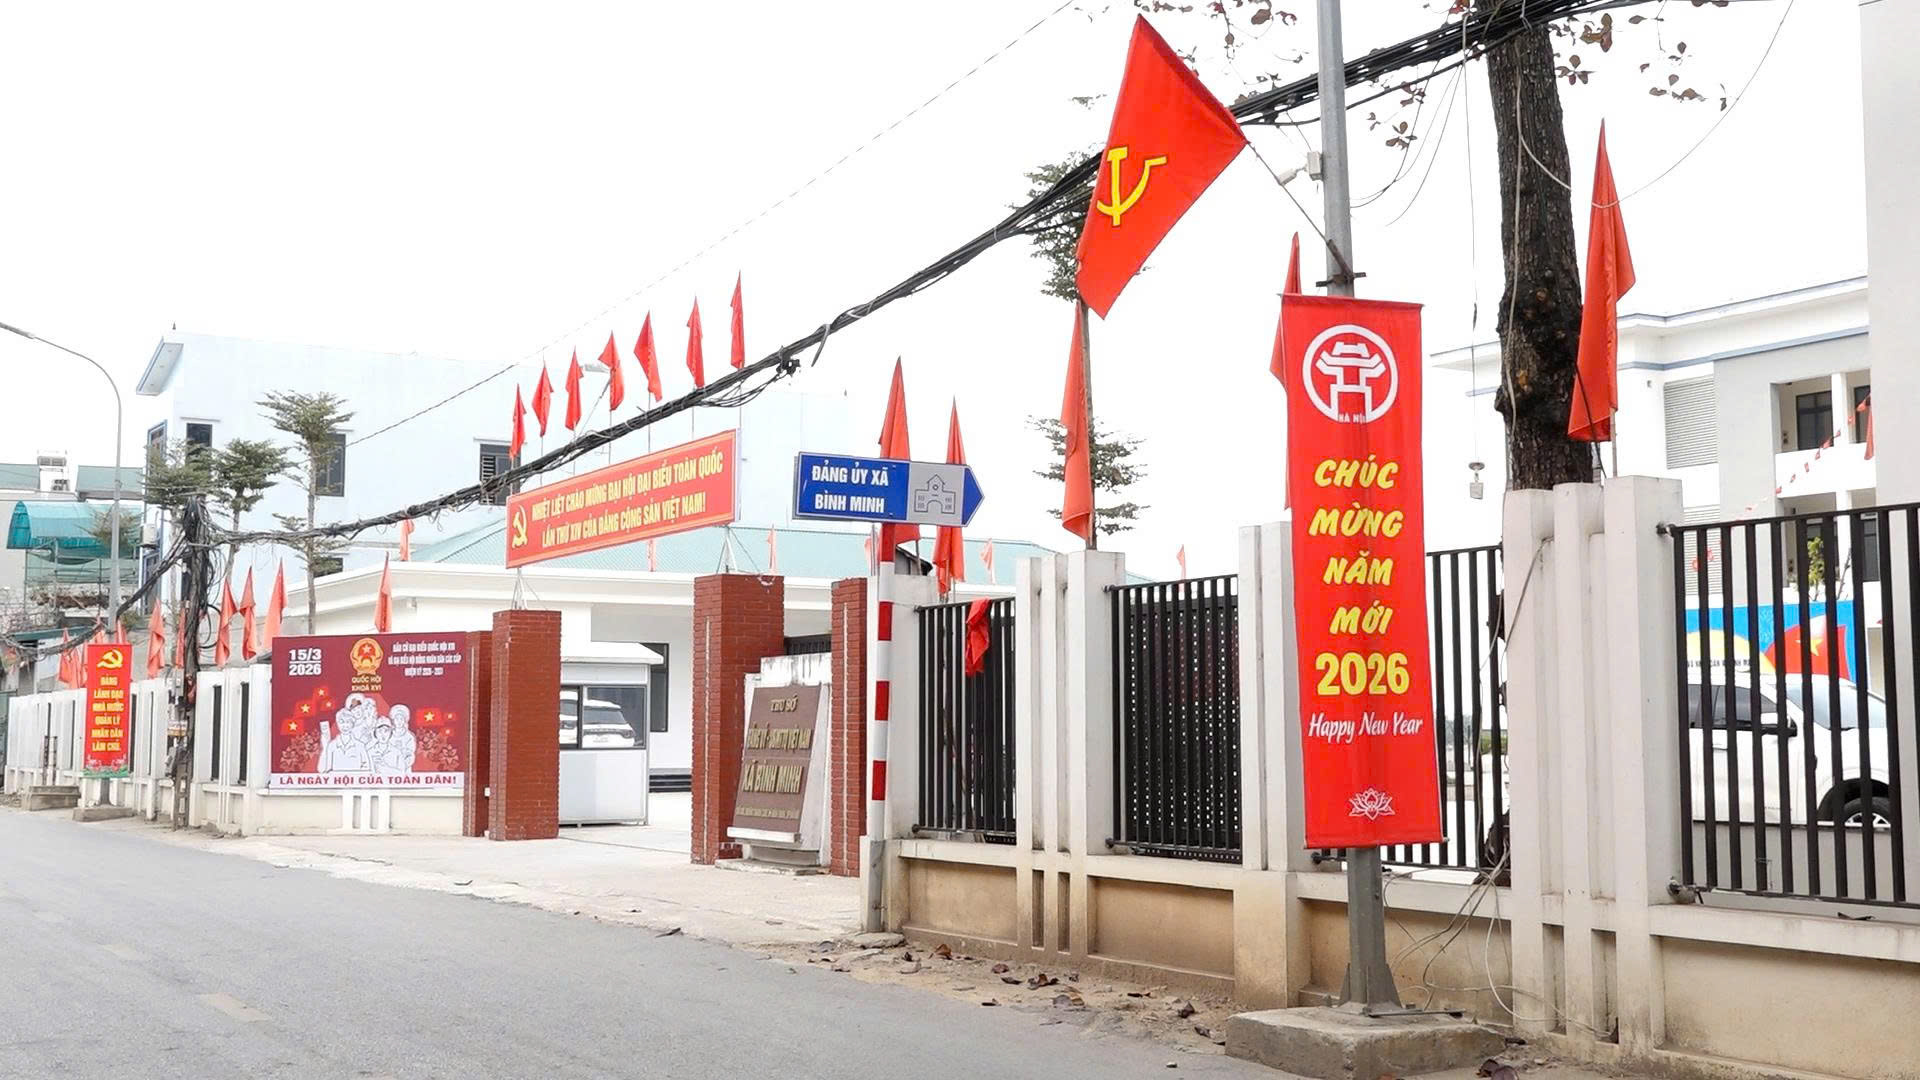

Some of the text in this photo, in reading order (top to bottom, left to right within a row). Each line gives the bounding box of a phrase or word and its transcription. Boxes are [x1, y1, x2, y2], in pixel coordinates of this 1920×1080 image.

[551, 494, 565, 518] LIỆT
[566, 488, 585, 512] CHÀO
[585, 483, 607, 507] MỪNG
[608, 480, 621, 504] ĐẠI
[623, 473, 636, 500] HỘI
[637, 471, 651, 496] ĐẠI
[652, 459, 672, 489] BIỂU
[673, 457, 697, 483] TOÀN
[699, 446, 723, 479] QUỐC
[812, 460, 889, 486] ĐẢNG ỦY XÃ
[1314, 454, 1398, 489] CHÚC
[814, 490, 885, 513] BÌNH MINH
[542, 524, 556, 548] LẦN
[583, 513, 598, 538] CỦA
[599, 509, 619, 535] ĐẢNG
[621, 506, 642, 533] CỘNG
[643, 498, 660, 525] SẢN
[662, 495, 680, 523] VIỆT
[682, 492, 706, 516] NAM!
[1309, 502, 1404, 538] MỪNG
[1323, 550, 1394, 586] NĂM
[1329, 600, 1394, 634] MỚI
[289, 648, 322, 661] 15/3
[289, 664, 322, 676] 2026
[1315, 652, 1410, 696] 2026
[1308, 712, 1423, 744] Happy New Year
[280, 773, 456, 786] LÀ NGÀY HỘI CỦA TOÀN DÂN!
[754, 760, 777, 792] BÌNH
[777, 766, 802, 793] MINH
